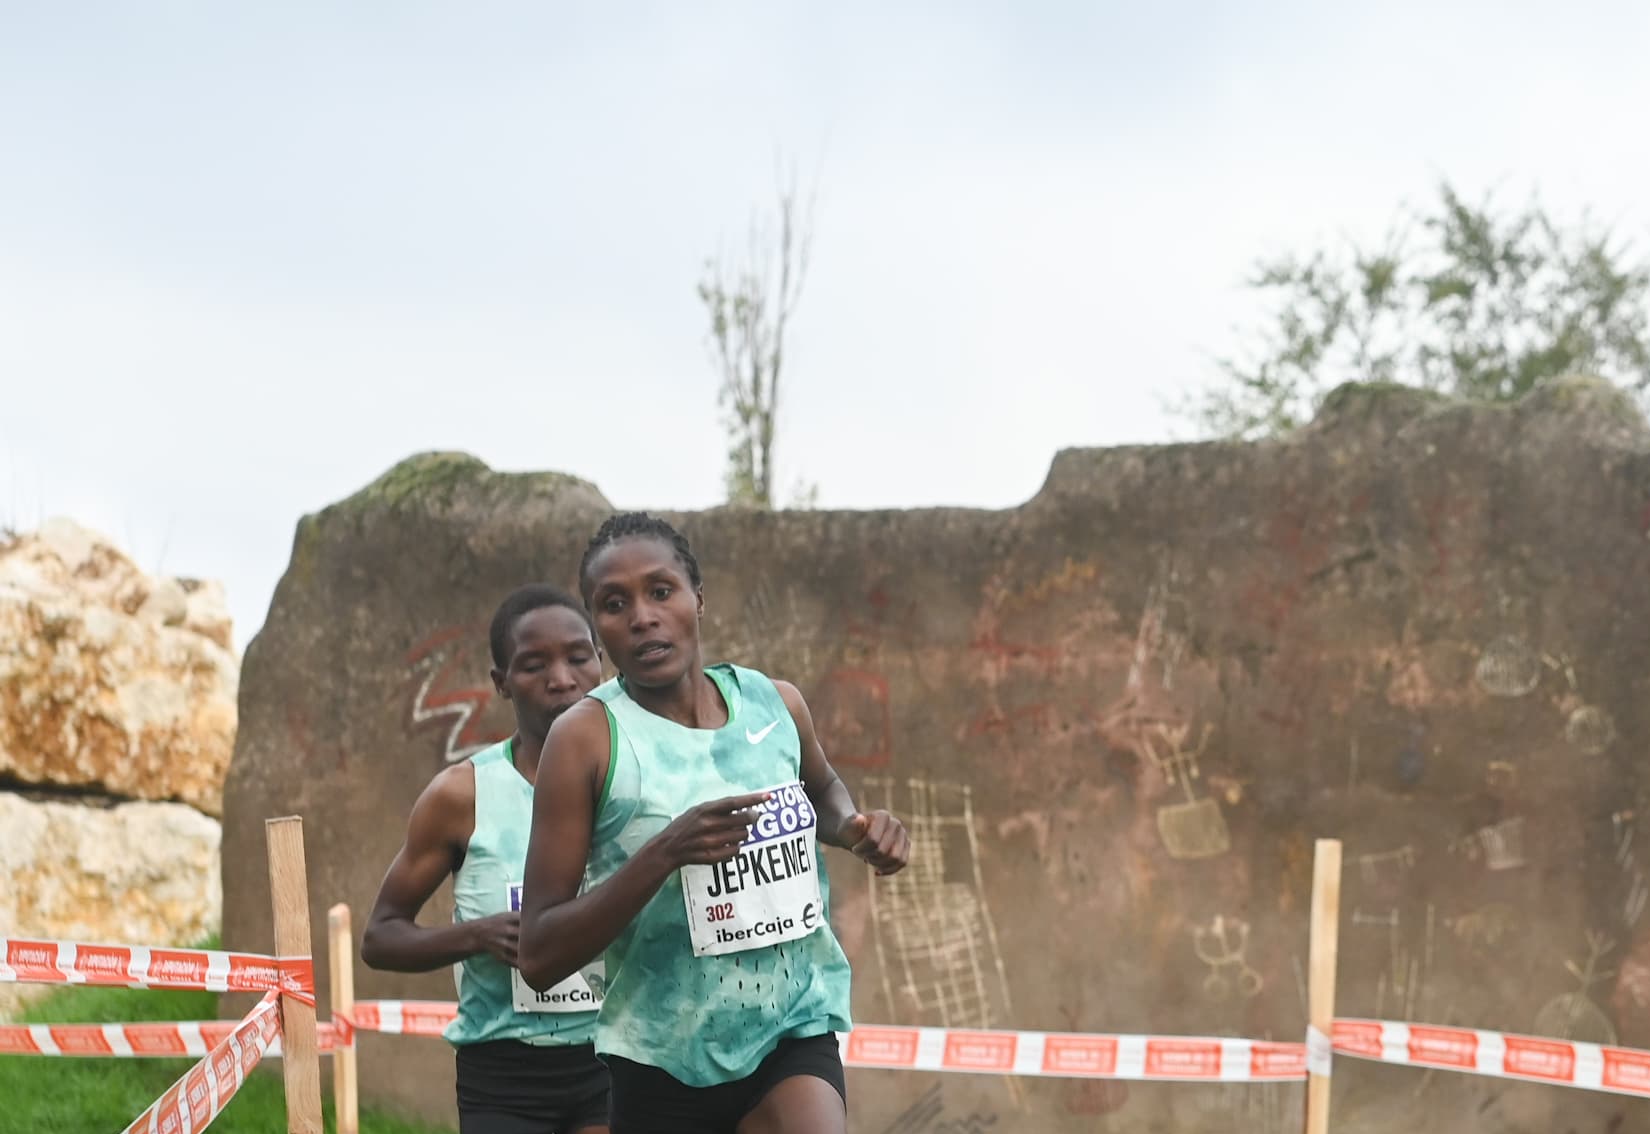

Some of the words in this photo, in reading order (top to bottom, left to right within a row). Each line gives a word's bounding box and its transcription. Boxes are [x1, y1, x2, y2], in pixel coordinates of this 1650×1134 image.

[707, 835, 811, 898] JEPKEMEI
[706, 903, 735, 922] 302
[716, 917, 794, 943] iberCaja
[536, 989, 596, 1004] iberCaj
